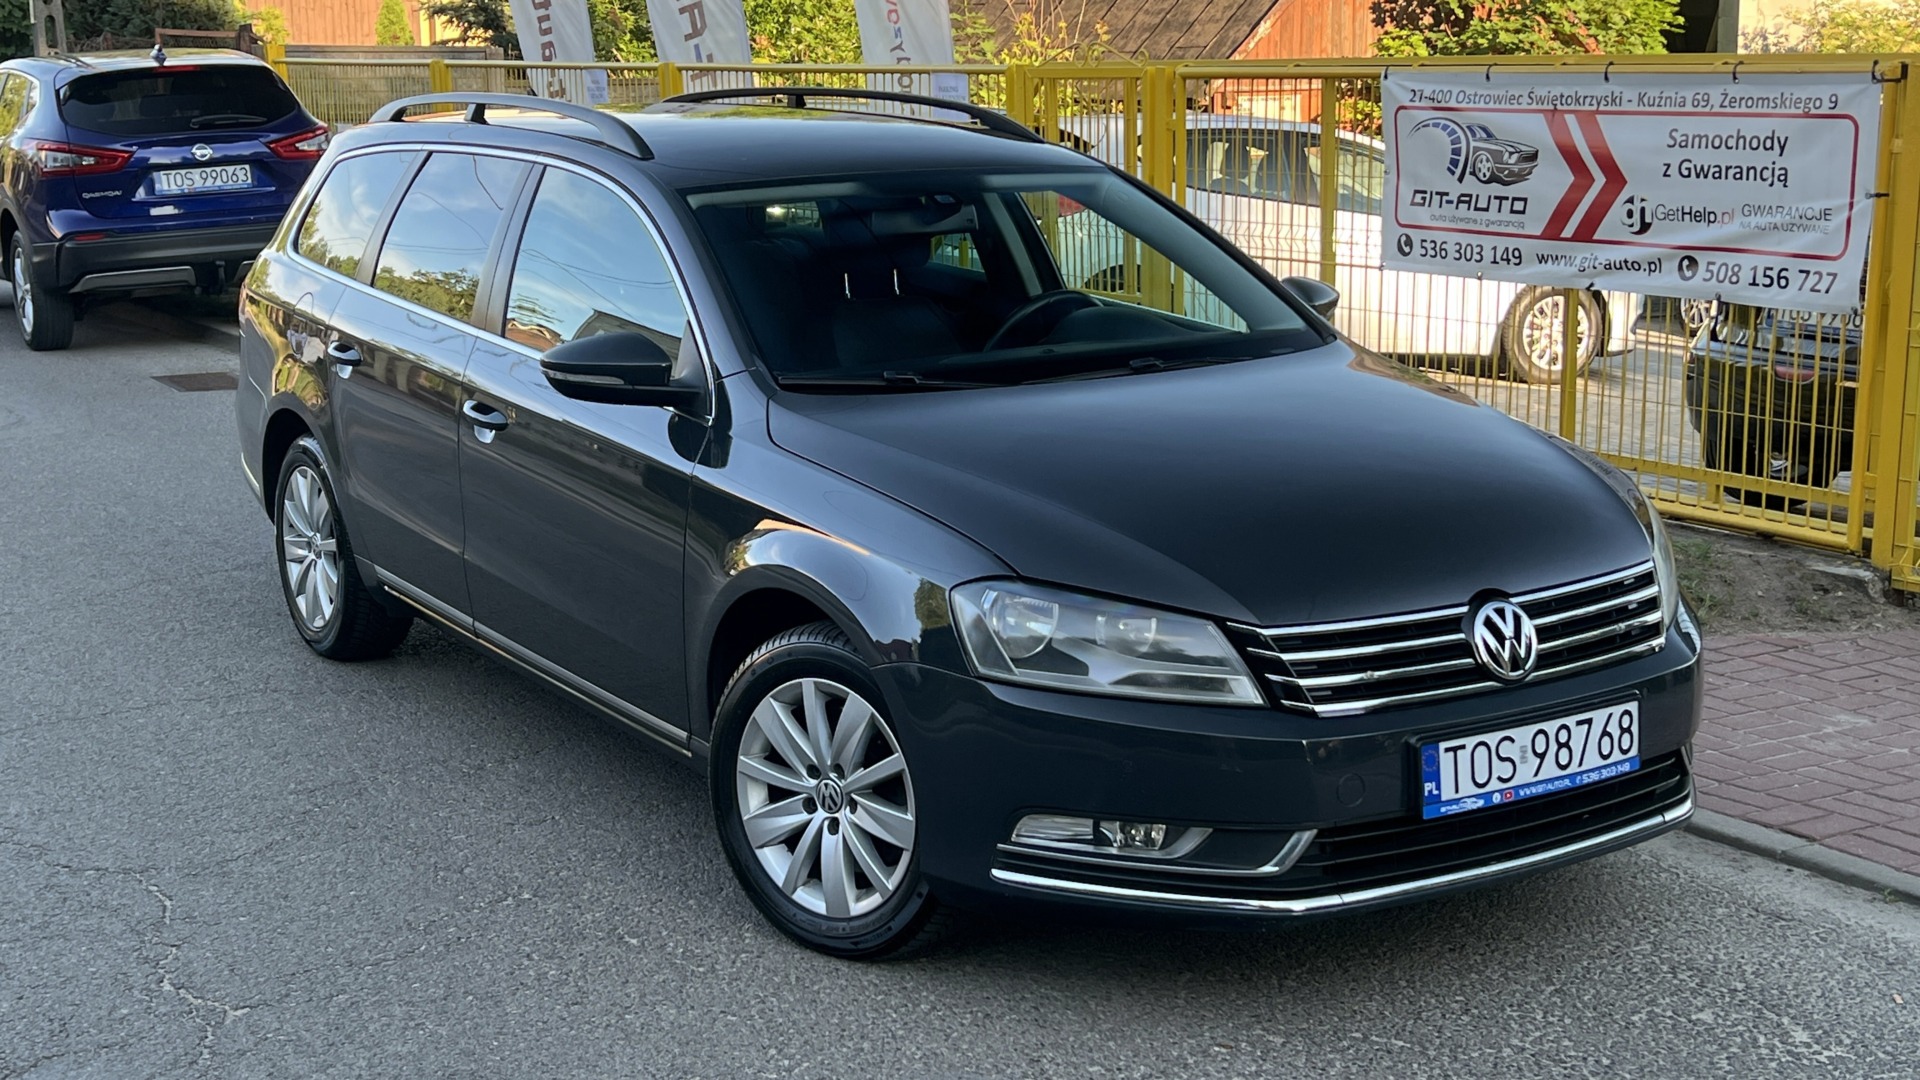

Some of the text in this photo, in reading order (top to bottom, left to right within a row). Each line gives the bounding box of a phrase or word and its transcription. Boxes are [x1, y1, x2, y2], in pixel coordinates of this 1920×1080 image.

[1409, 89, 1452, 104] 27-400
[1455, 89, 1523, 106] Ostrowiec
[1527, 86, 1623, 111] Świętokrzyski
[1637, 90, 1686, 108] Kuźnia
[1691, 91, 1714, 111] 69,
[1719, 88, 1823, 114] Żeromskiego
[1828, 93, 1839, 110] 9
[1666, 128, 1789, 157] Samochody
[162, 166, 249, 188] TOS 99063
[1662, 158, 1789, 188] z Gwarancją
[1409, 189, 1528, 215] GIT-AUTO
[1741, 203, 1833, 222] GWARANCJE
[1654, 203, 1735, 228] GetHelp.pl
[1753, 221, 1780, 232] AUTA
[1420, 238, 1523, 266] 536 303 149
[1536, 252, 1662, 277] www.git-auto.pl
[1702, 260, 1838, 294] 508 156 727
[1443, 708, 1634, 795] TOS 98768
[1423, 781, 1440, 797] PL
